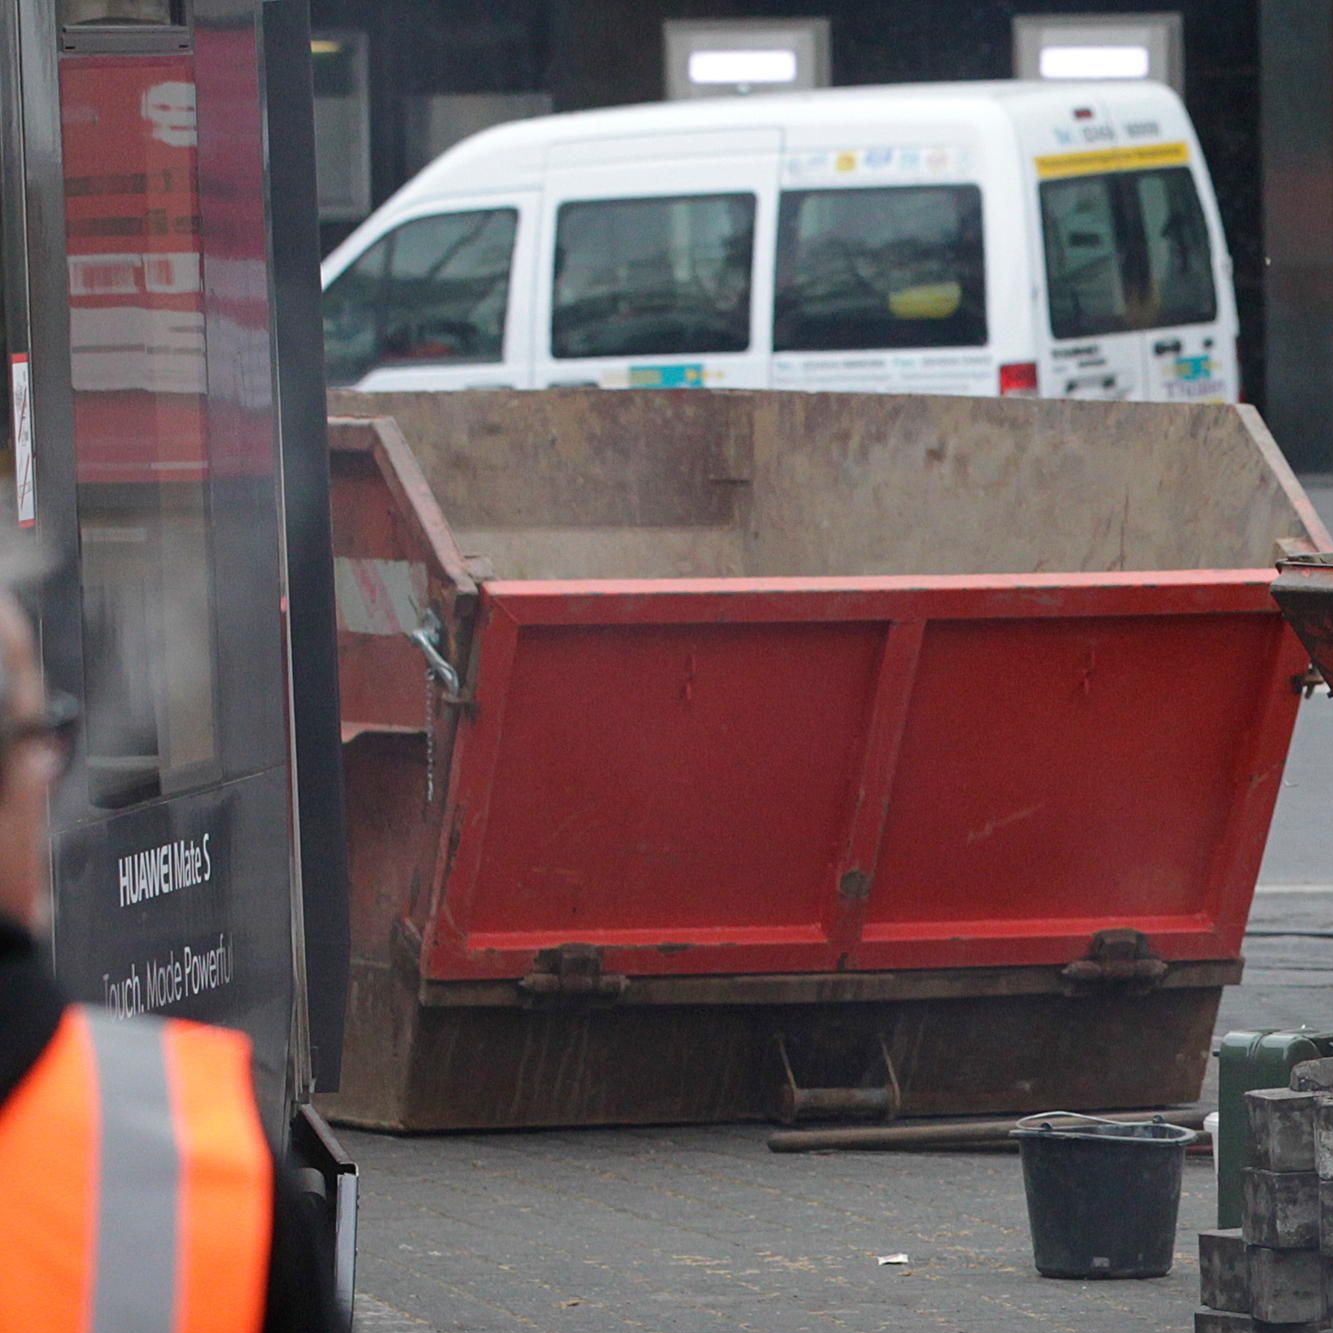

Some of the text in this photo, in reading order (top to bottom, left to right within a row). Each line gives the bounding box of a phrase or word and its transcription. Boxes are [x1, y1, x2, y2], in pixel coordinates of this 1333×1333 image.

[118, 832, 211, 907] HUAWEI Mate S
[103, 932, 233, 1021] Touch. Made Powerful
